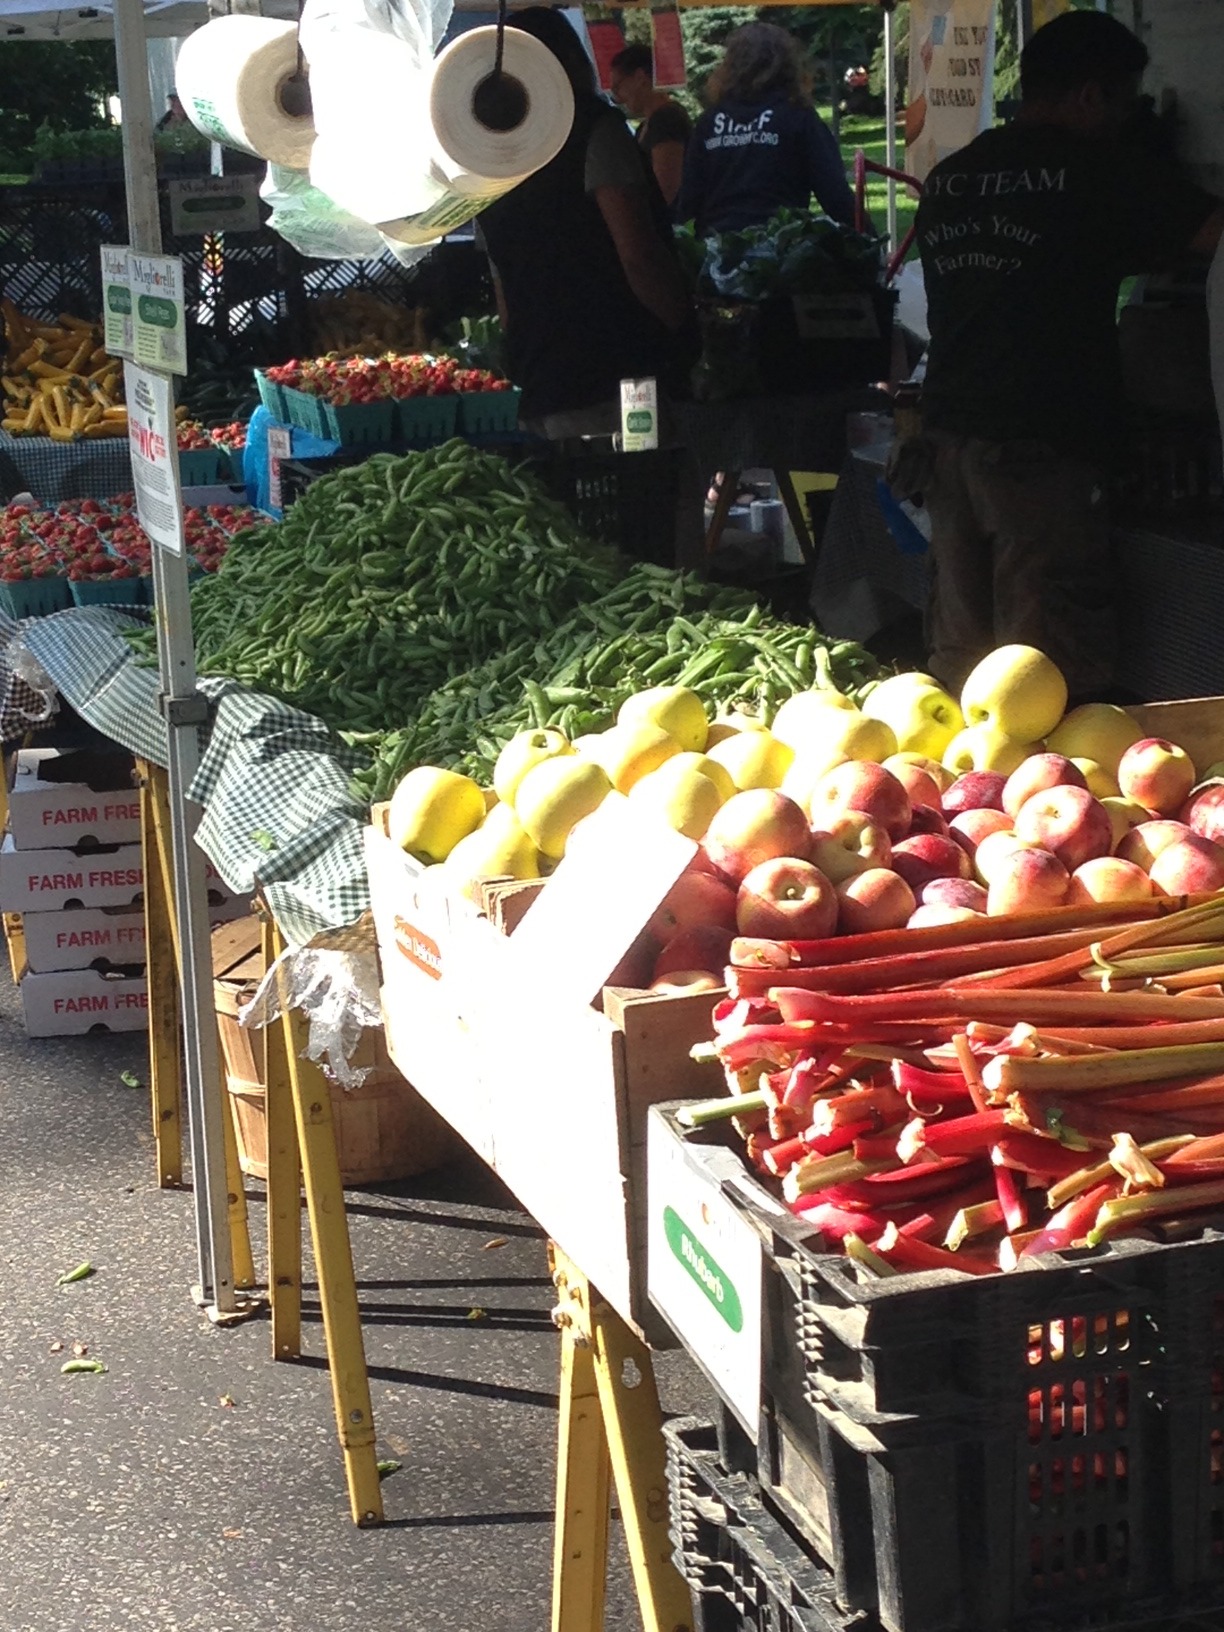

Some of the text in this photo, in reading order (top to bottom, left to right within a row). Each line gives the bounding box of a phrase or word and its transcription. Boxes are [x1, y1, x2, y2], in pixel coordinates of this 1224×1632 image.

[968, 58, 981, 76] ST
[713, 109, 774, 134] STAFF
[976, 167, 1066, 196] TEAM
[924, 215, 1042, 246] Who's Your
[133, 260, 176, 288] Migliorelli
[934, 252, 1022, 275] Farmer?
[42, 803, 141, 825] FARM FRE
[28, 873, 83, 891] FARM
[56, 930, 110, 948] FARM
[53, 993, 148, 1014] FARM FRE
[681, 1233, 724, 1303] Rhubarb
